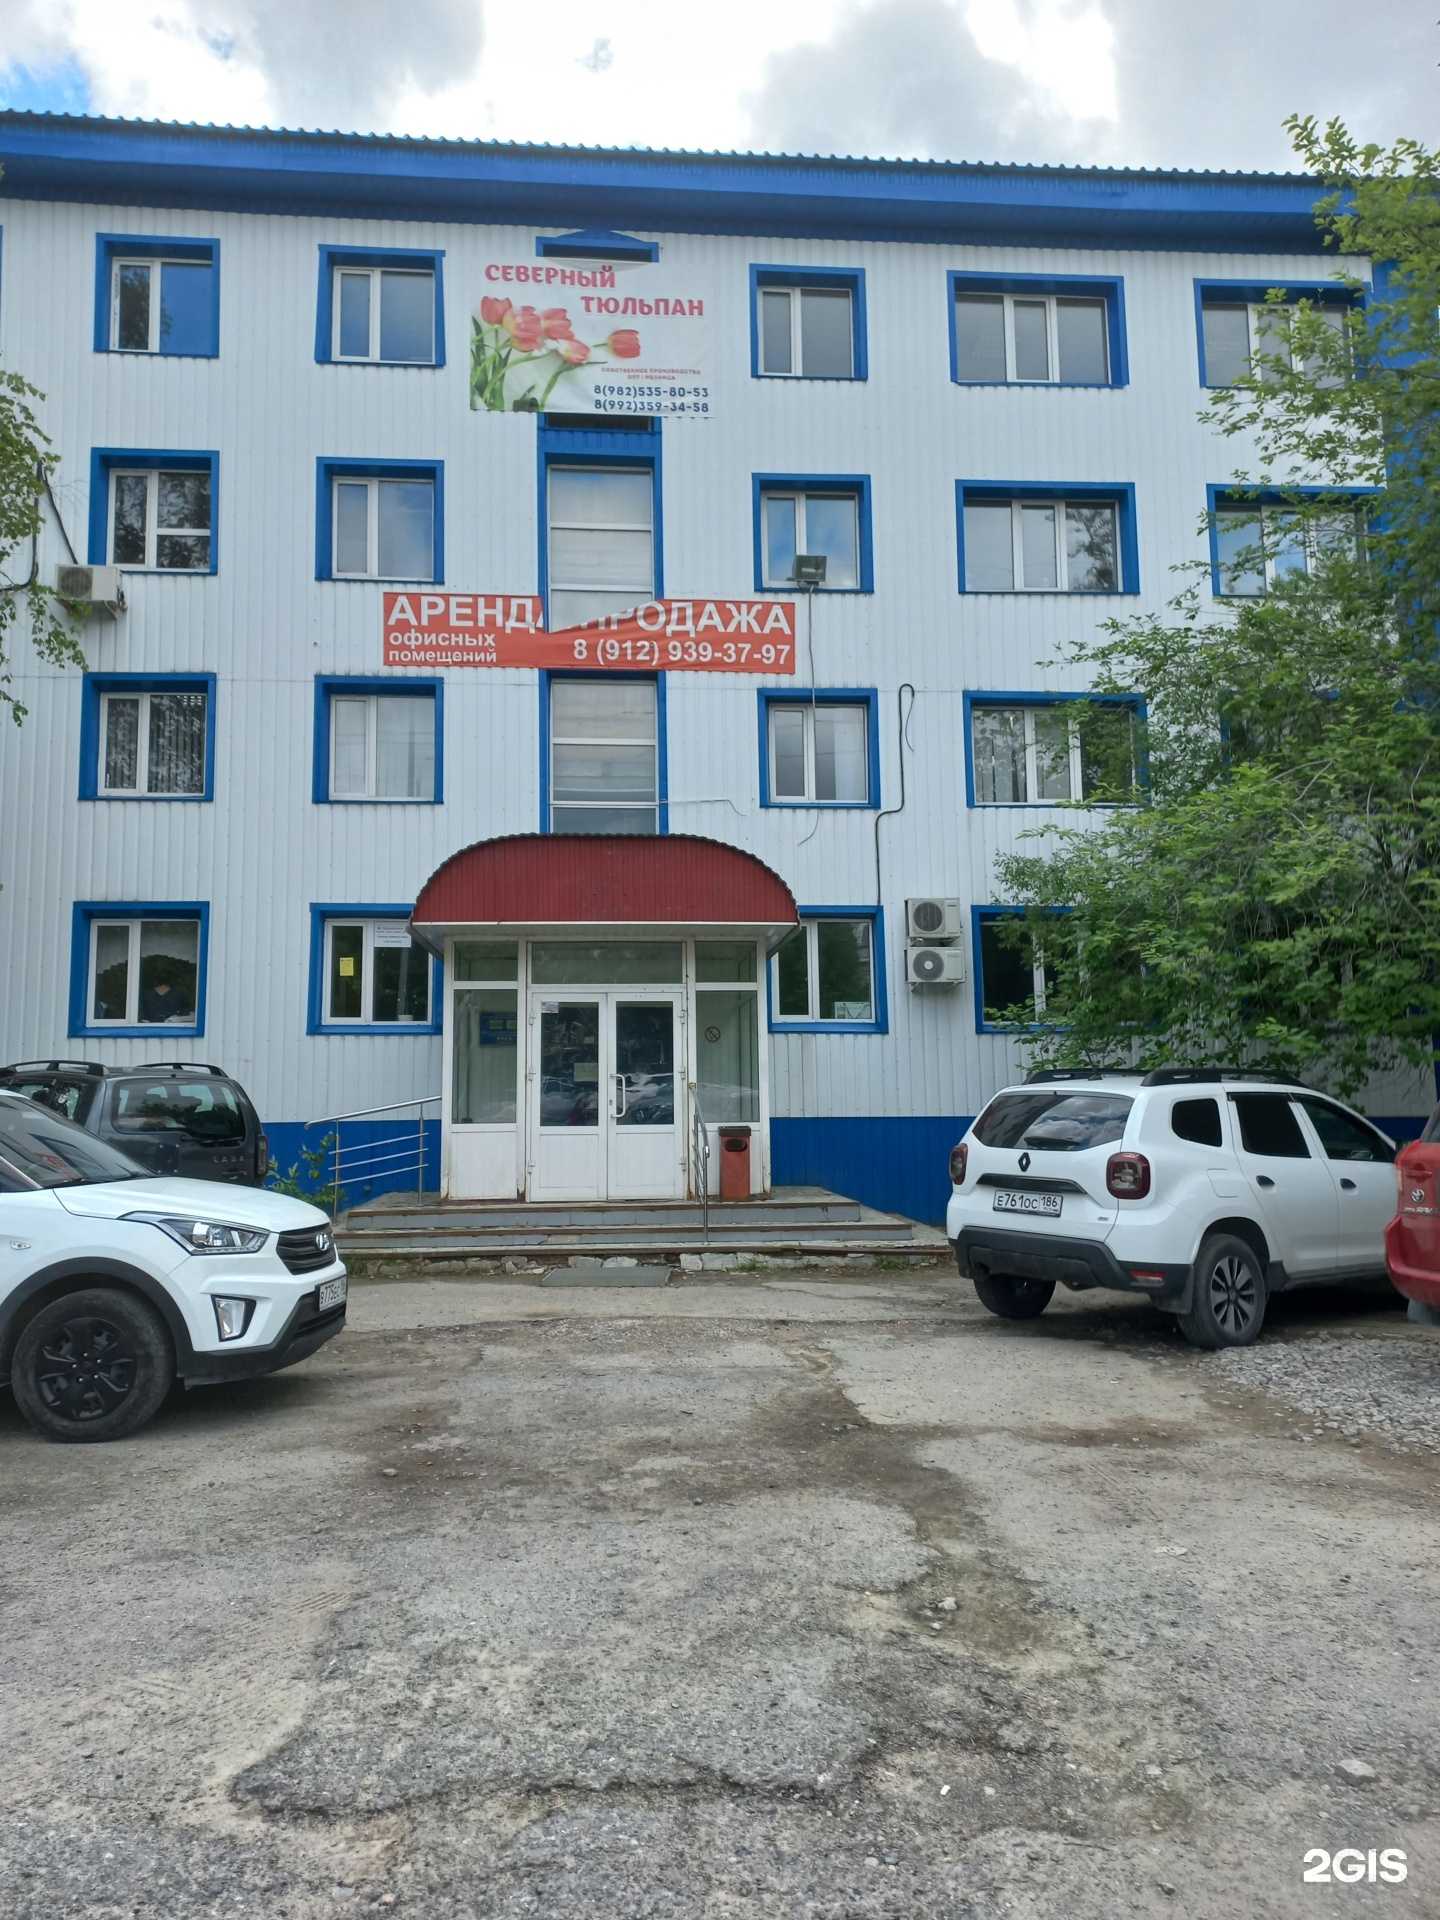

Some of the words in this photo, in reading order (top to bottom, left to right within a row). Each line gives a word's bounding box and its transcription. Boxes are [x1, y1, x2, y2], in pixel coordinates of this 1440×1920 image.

[485, 264, 615, 288] СЕВЕРНЫЙ
[580, 296, 704, 316] ТЮЛЬПАН
[594, 385, 709, 398] 8(982)535-80-53
[594, 399, 709, 412] 8(992)359-34-58
[387, 595, 543, 634] АРЕНД
[389, 628, 496, 649] офисных
[389, 648, 497, 664] помещений
[574, 639, 588, 660] 8
[597, 639, 660, 665] (912)
[668, 641, 791, 664] 939-37-97
[1041, 1196, 1058, 1207] 186
